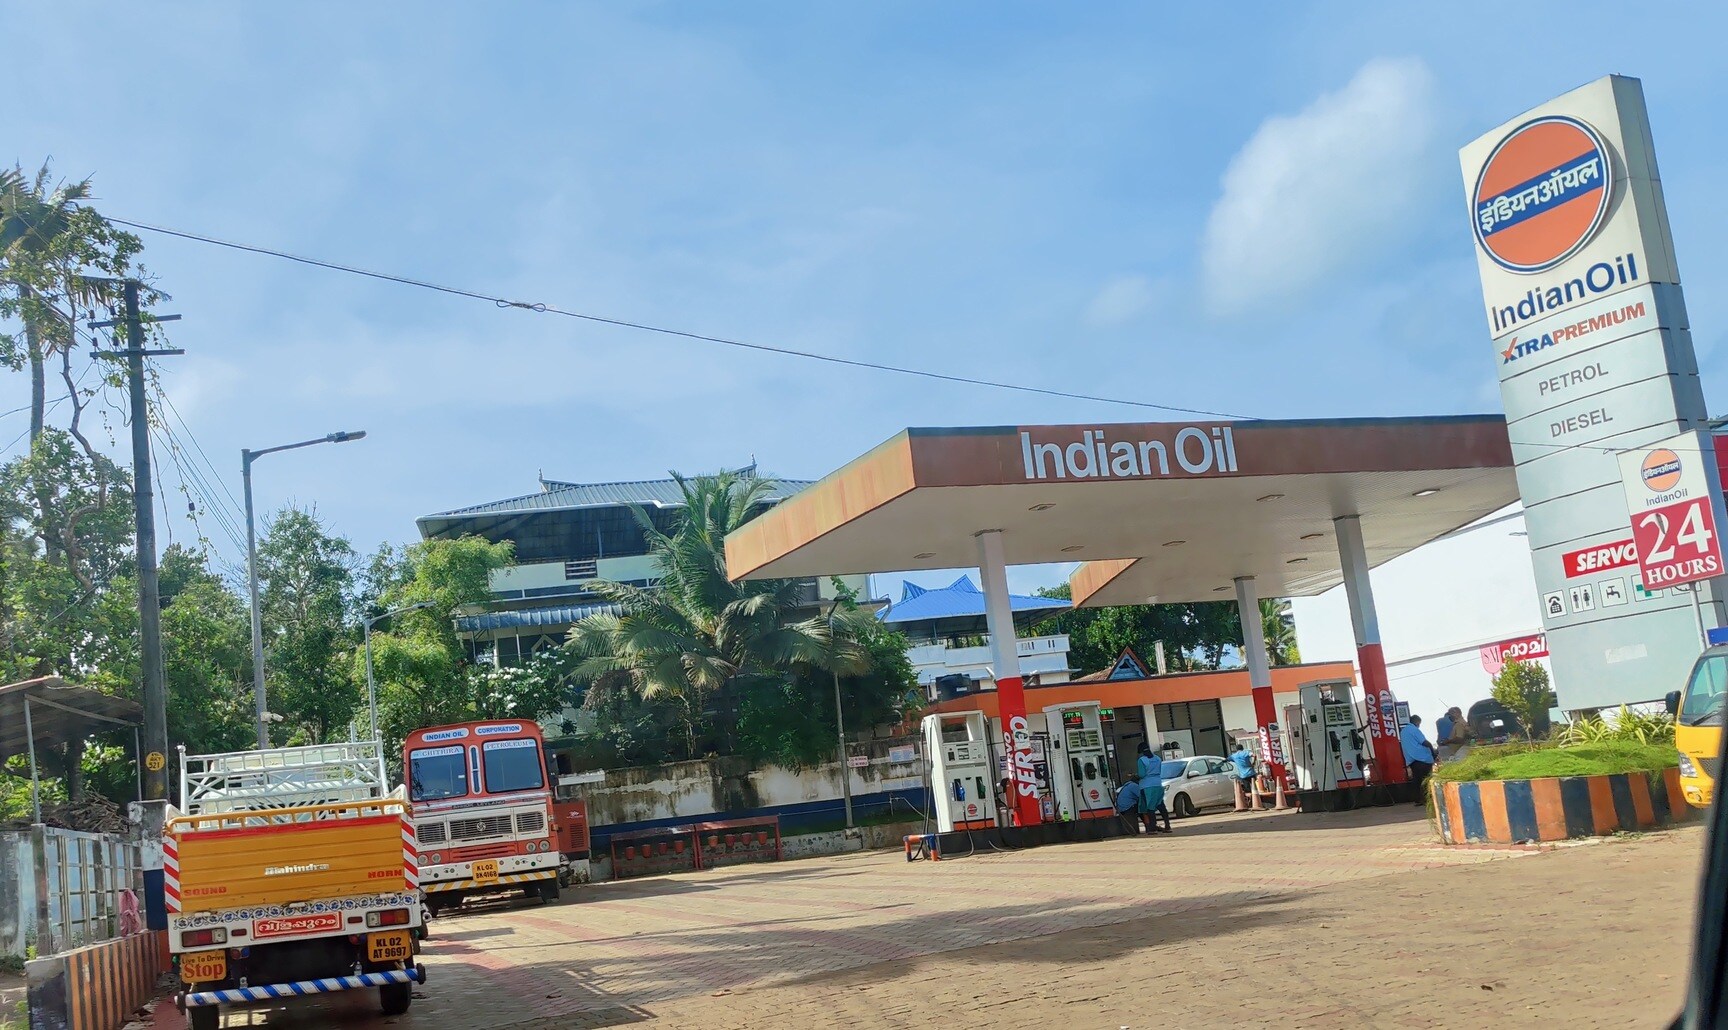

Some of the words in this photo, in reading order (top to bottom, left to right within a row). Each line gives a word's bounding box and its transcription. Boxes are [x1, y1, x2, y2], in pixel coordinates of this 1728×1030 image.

[1479, 157, 1599, 232] इंडियनऑयल
[1492, 253, 1638, 332] IndianOil
[1501, 302, 1645, 364] XTRAPREMIUM
[1539, 363, 1609, 396] PETROL
[1550, 408, 1613, 438] DIESEL
[1020, 430, 1170, 479] Indian
[1174, 426, 1239, 474] Oil
[1646, 488, 1689, 507] IndianOil
[1639, 502, 1713, 565] 24
[1576, 543, 1638, 572] SERVO
[1646, 555, 1718, 585] HOURS
[1366, 694, 1381, 738] SERVO
[1379, 689, 1397, 737] SERO
[426, 733, 451, 741] INDIAN
[477, 725, 520, 734] CORPORATION
[1260, 726, 1272, 763] SERVO
[486, 741, 528, 749] PETROLEUM
[1003, 731, 1016, 780] SERVO
[1010, 716, 1040, 799] SERO
[368, 869, 403, 879] HORN
[184, 886, 227, 896] SOUND
[373, 948, 383, 959] AT
[385, 946, 407, 958] 9697
[376, 938, 388, 948] KL
[389, 936, 402, 947] 02
[184, 963, 224, 979] Stop
